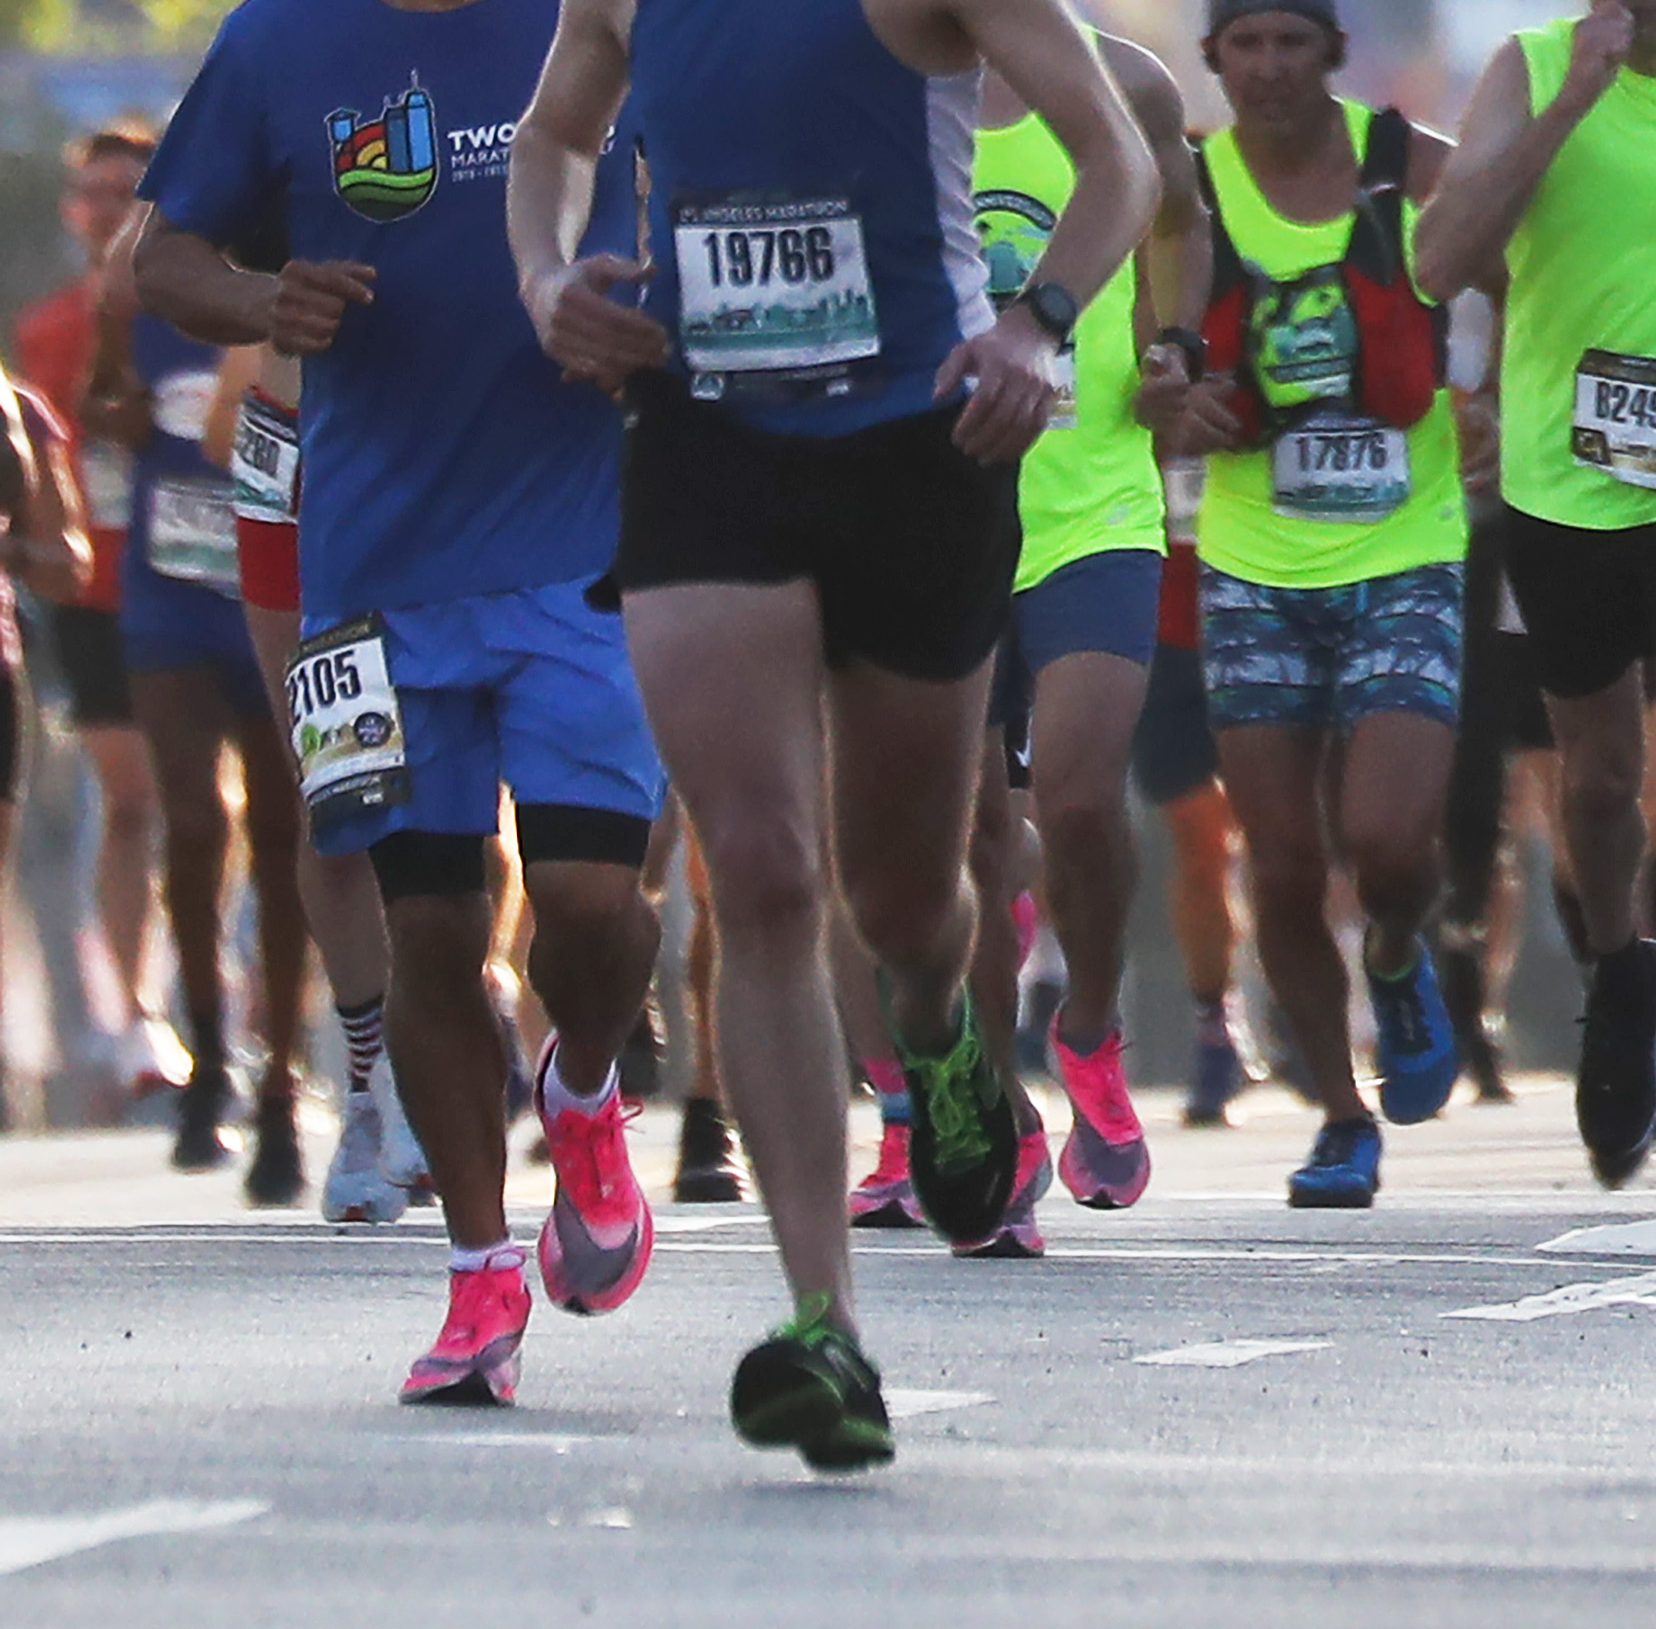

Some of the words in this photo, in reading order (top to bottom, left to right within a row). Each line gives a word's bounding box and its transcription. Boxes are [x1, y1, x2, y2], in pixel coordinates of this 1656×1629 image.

[448, 123, 518, 151] TWO
[451, 148, 511, 168] MARAT
[703, 226, 834, 288] 19766
[1295, 432, 1388, 473] 17876
